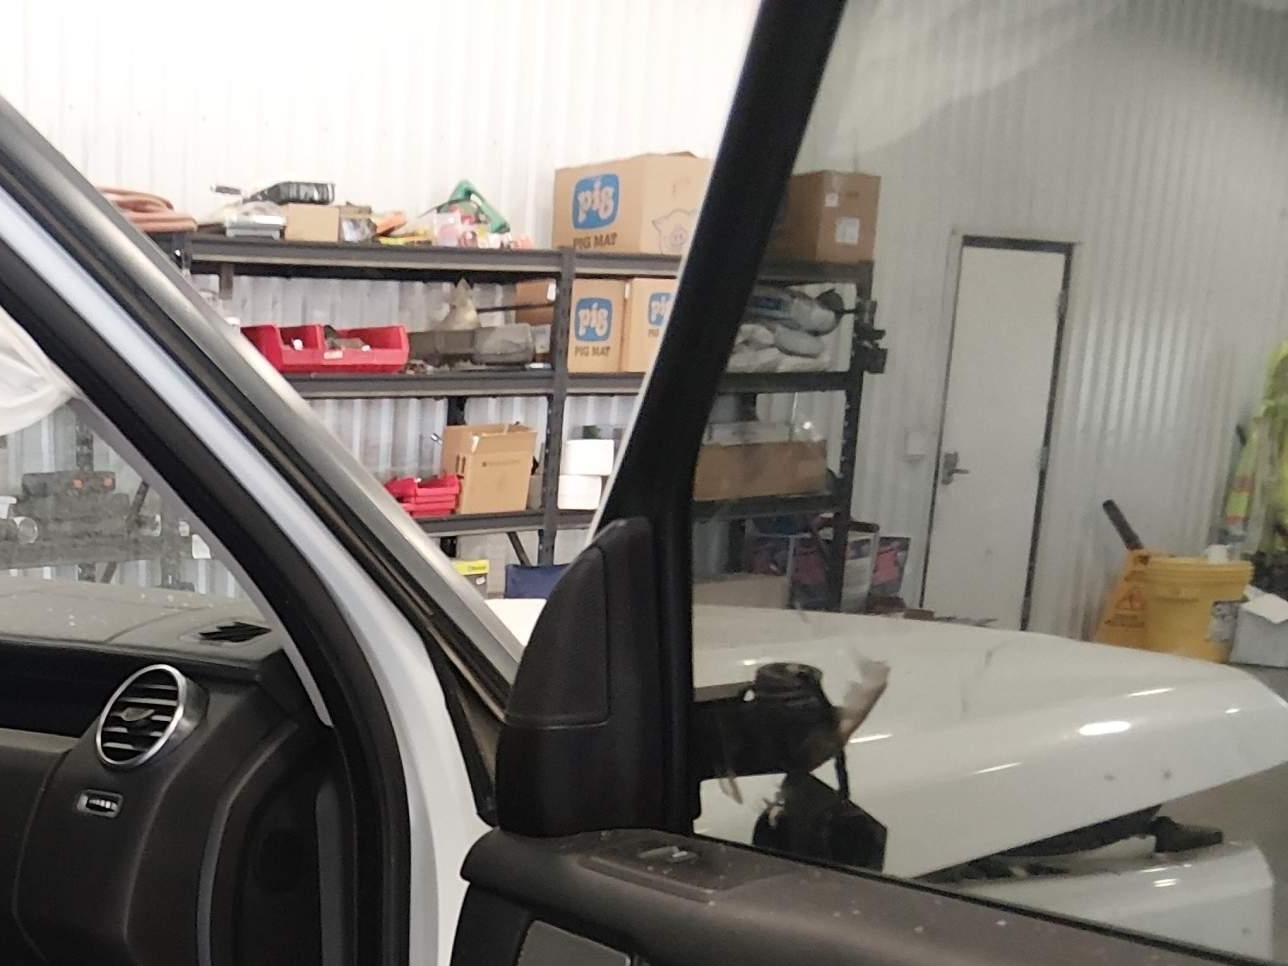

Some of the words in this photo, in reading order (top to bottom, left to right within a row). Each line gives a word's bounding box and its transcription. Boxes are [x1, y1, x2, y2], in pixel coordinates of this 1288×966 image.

[573, 236, 592, 249] PIG
[593, 232, 618, 248] MAT
[574, 346, 590, 357] PIG
[591, 346, 611, 357] MAT
